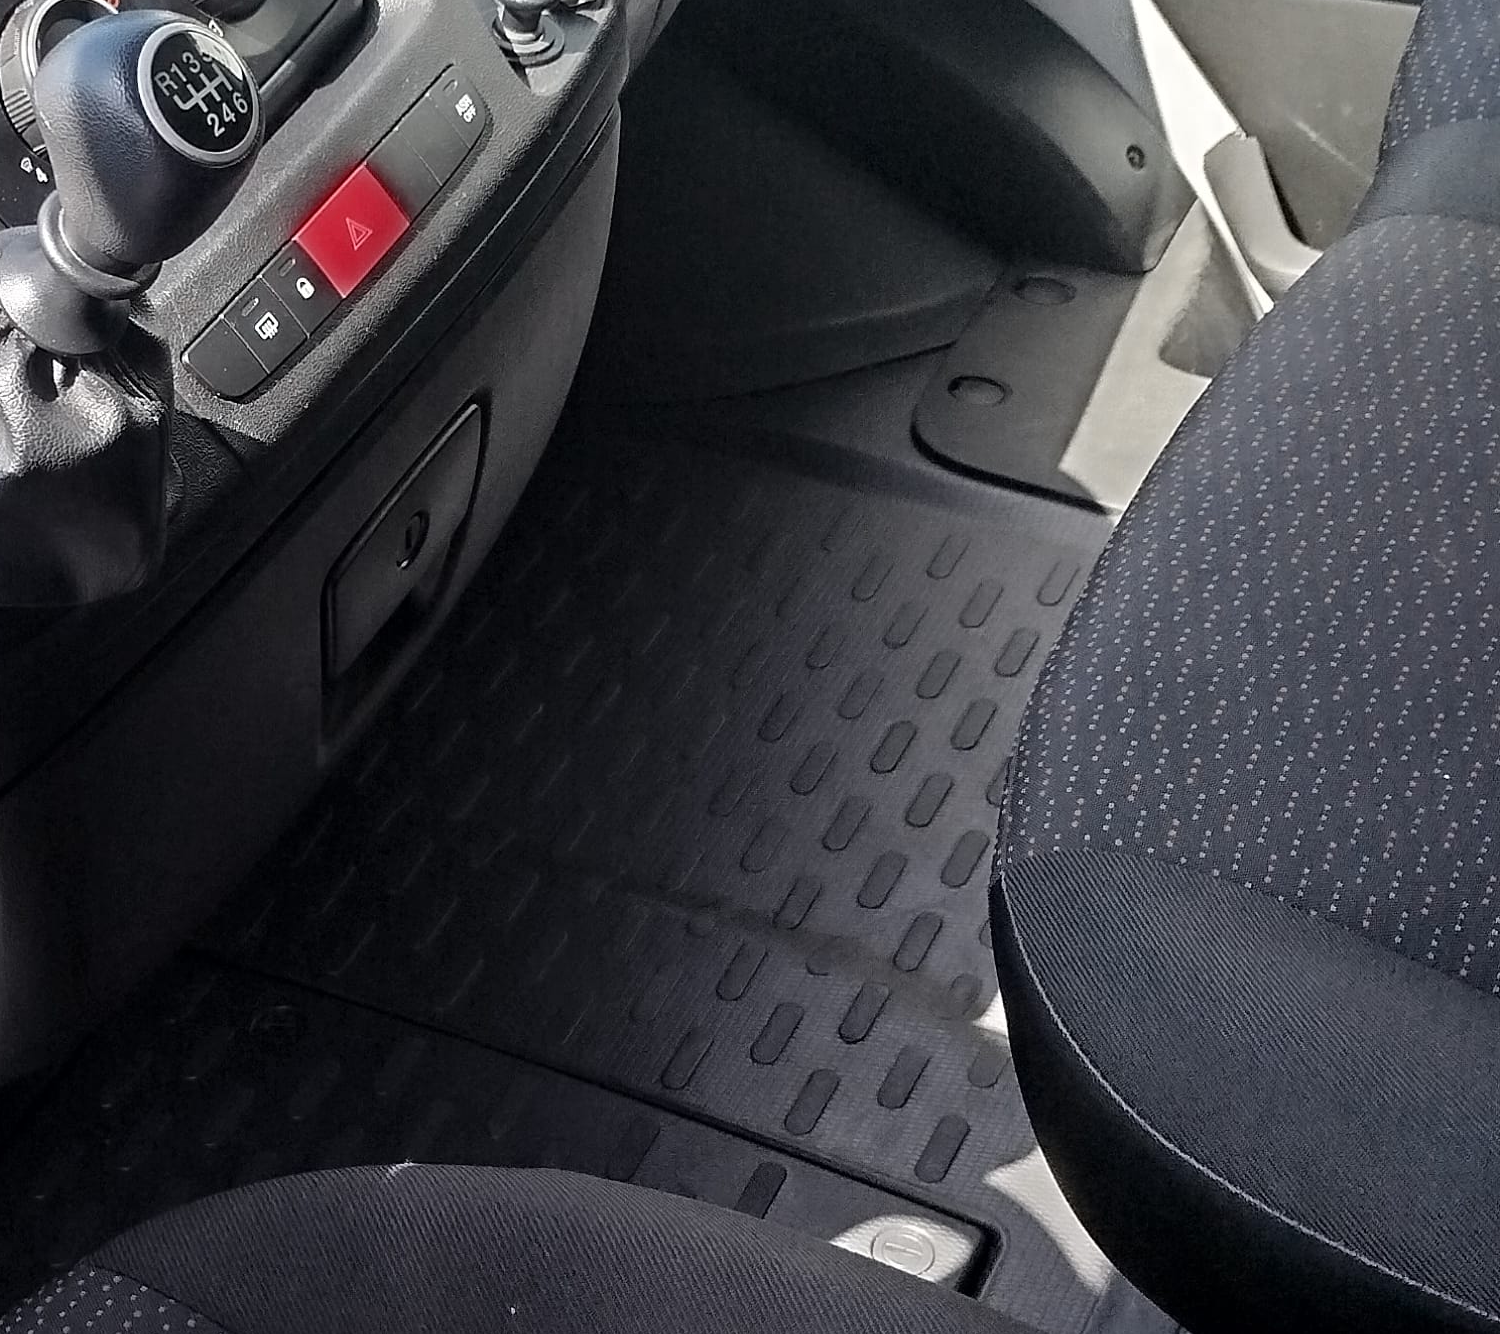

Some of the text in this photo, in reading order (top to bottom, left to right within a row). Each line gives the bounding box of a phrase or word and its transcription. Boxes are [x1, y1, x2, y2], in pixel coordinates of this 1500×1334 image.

[155, 51, 201, 97] R 1 3
[206, 91, 248, 137] 2 4 6
